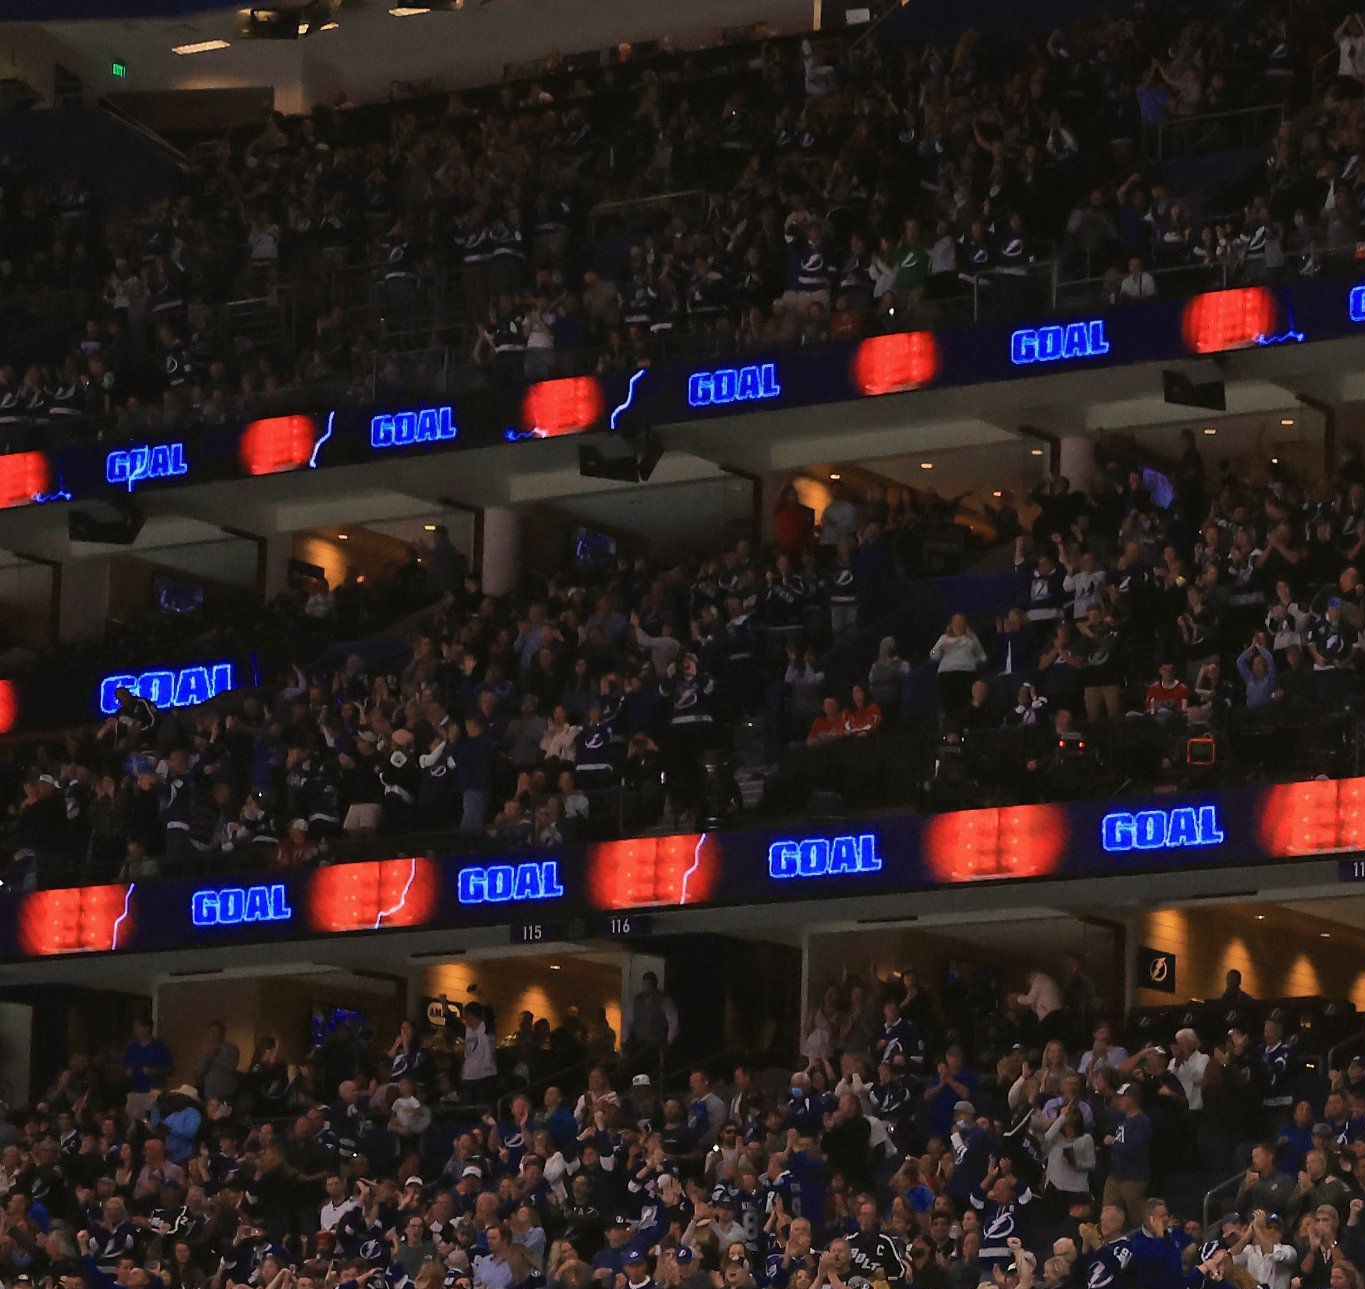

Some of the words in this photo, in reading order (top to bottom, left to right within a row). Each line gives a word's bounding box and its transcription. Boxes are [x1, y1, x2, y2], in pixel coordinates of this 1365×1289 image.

[1011, 320, 1110, 364] GOAL
[688, 363, 781, 406] GOAL
[371, 407, 457, 448] GOAL
[107, 444, 187, 483] GOAL
[100, 662, 232, 714] GOAL
[1102, 804, 1225, 852] GOAL
[768, 834, 883, 879] GOAL
[457, 861, 564, 904] GOAL
[192, 884, 291, 926] GOAL
[612, 918, 631, 934] 116
[523, 925, 543, 940] 115
